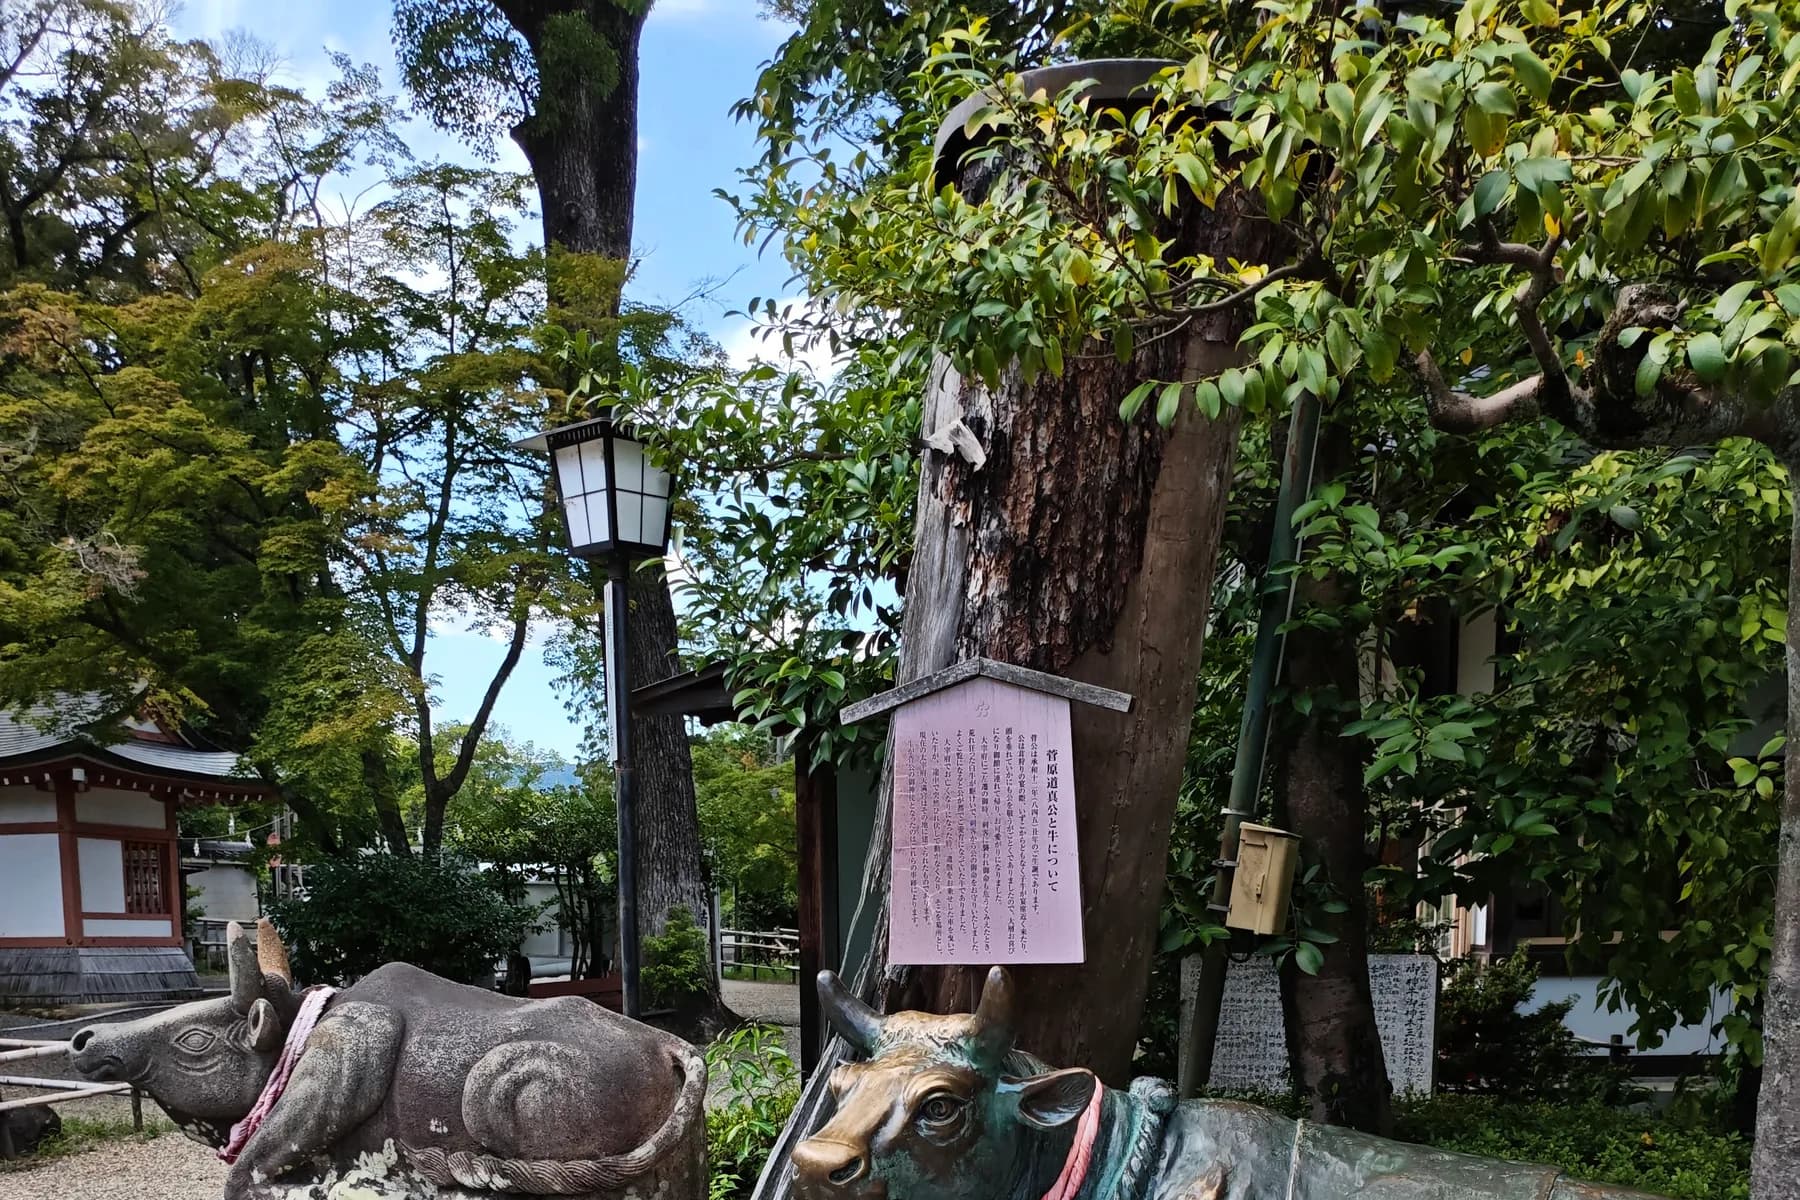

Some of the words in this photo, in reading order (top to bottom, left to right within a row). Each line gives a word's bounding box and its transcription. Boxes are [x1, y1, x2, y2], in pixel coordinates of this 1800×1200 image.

[1047, 749, 1059, 892] 菅原道真公と牛について
